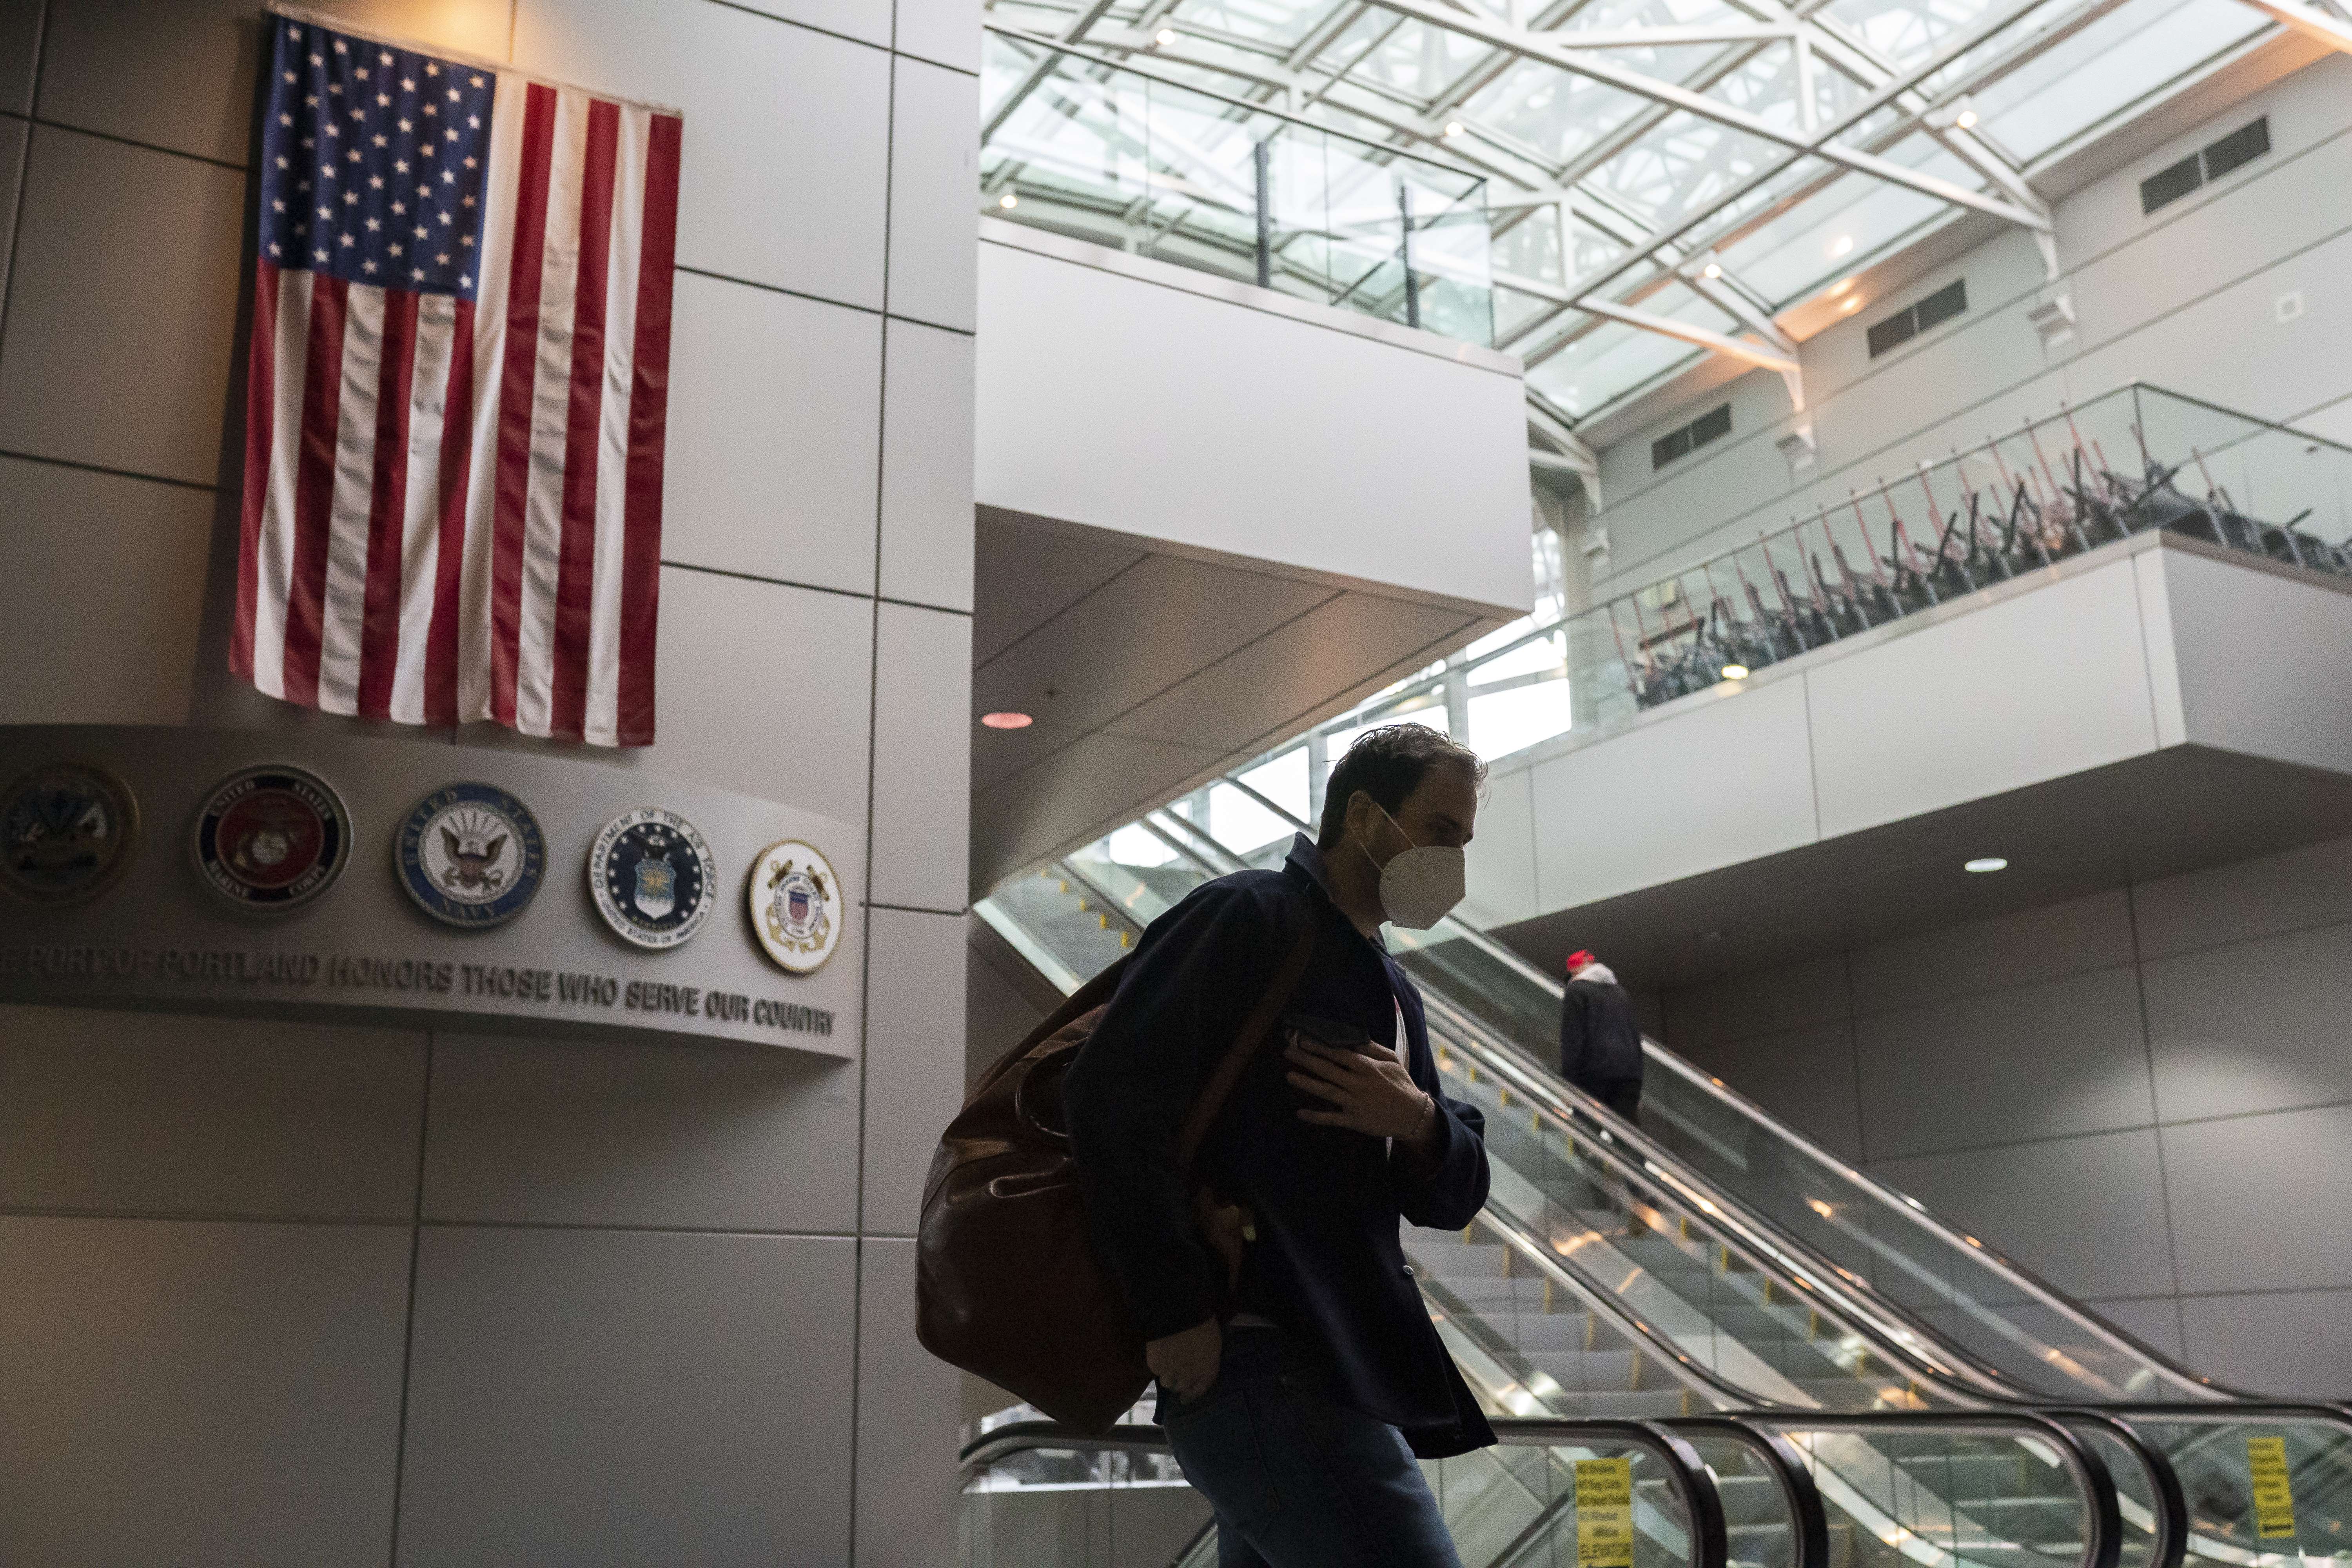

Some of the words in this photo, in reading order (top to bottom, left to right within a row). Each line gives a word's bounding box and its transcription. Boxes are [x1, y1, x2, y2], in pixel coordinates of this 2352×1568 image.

[405, 790, 459, 866] UNITED
[500, 797, 540, 878] STATES
[593, 813, 633, 889] DEPARTMENT
[640, 809, 654, 820] OF
[663, 811, 683, 829] THE
[442, 898, 495, 916] NAVY
[29, 945, 101, 976] PORT
[114, 946, 156, 977] OF
[159, 949, 319, 985] PORTLAND
[328, 954, 453, 992] HONORS
[461, 963, 553, 1000] THOSE
[558, 972, 619, 1007] WHO
[624, 980, 701, 1016] SERVE
[705, 989, 750, 1023] OUR
[753, 998, 836, 1037] COUNTRY
